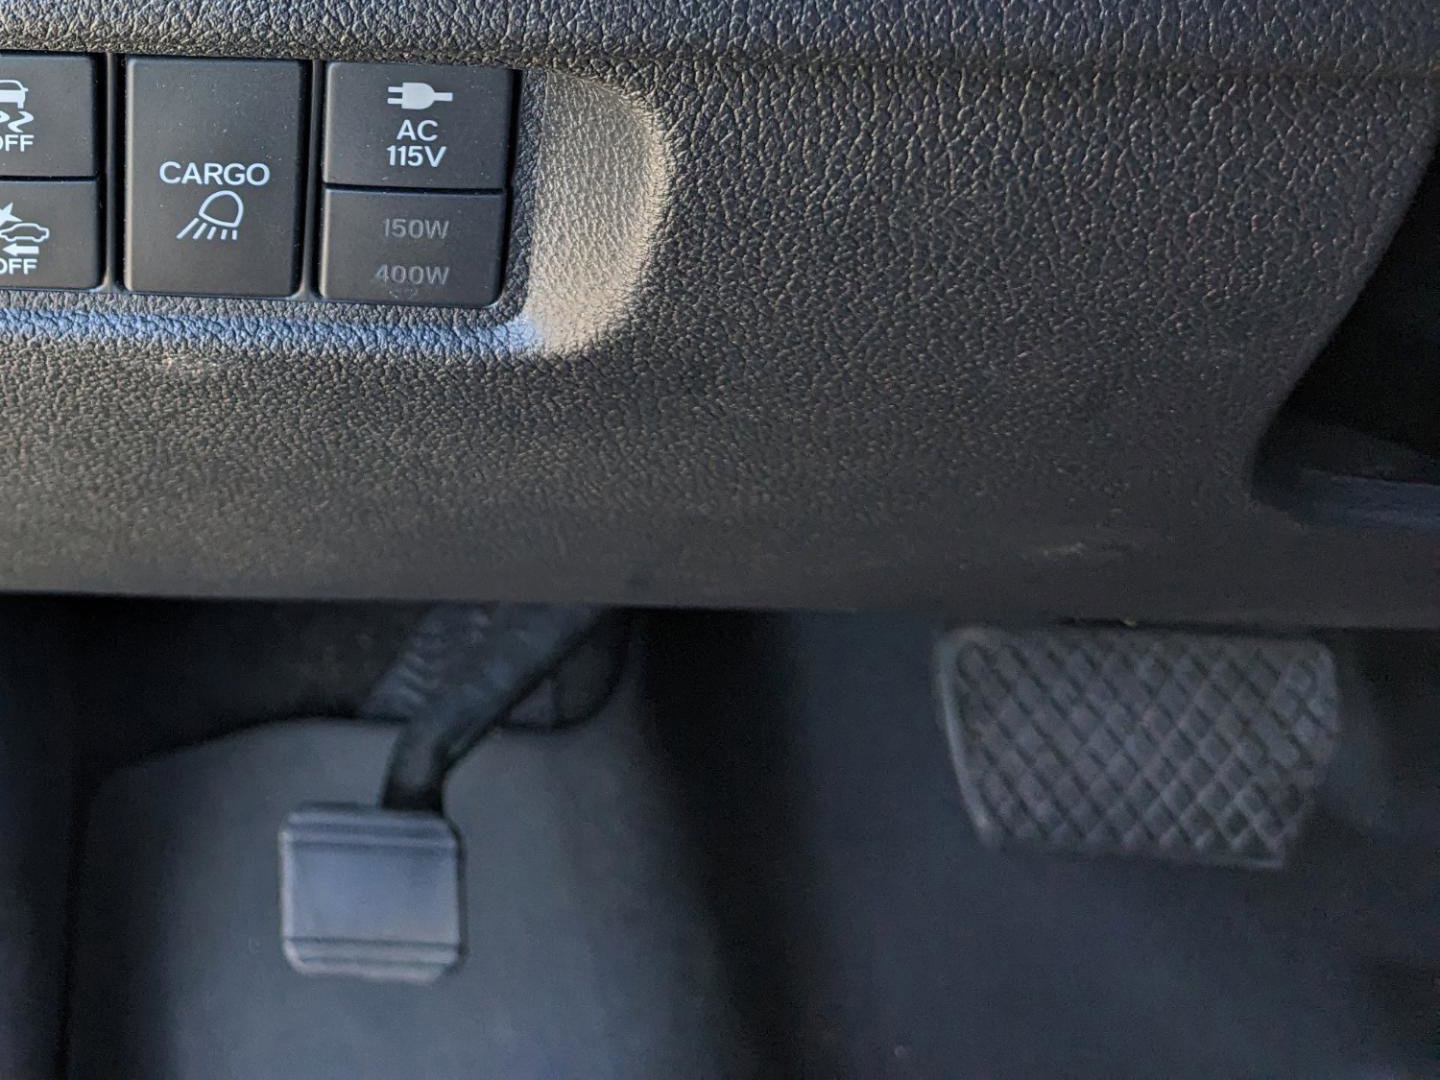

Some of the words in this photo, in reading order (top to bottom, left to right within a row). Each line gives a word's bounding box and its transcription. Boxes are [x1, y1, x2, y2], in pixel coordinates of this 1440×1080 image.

[396, 119, 439, 142] AC
[386, 145, 447, 168] 115V
[159, 161, 271, 186] CARGO
[382, 218, 450, 240] 150W
[375, 265, 450, 286] 400W
